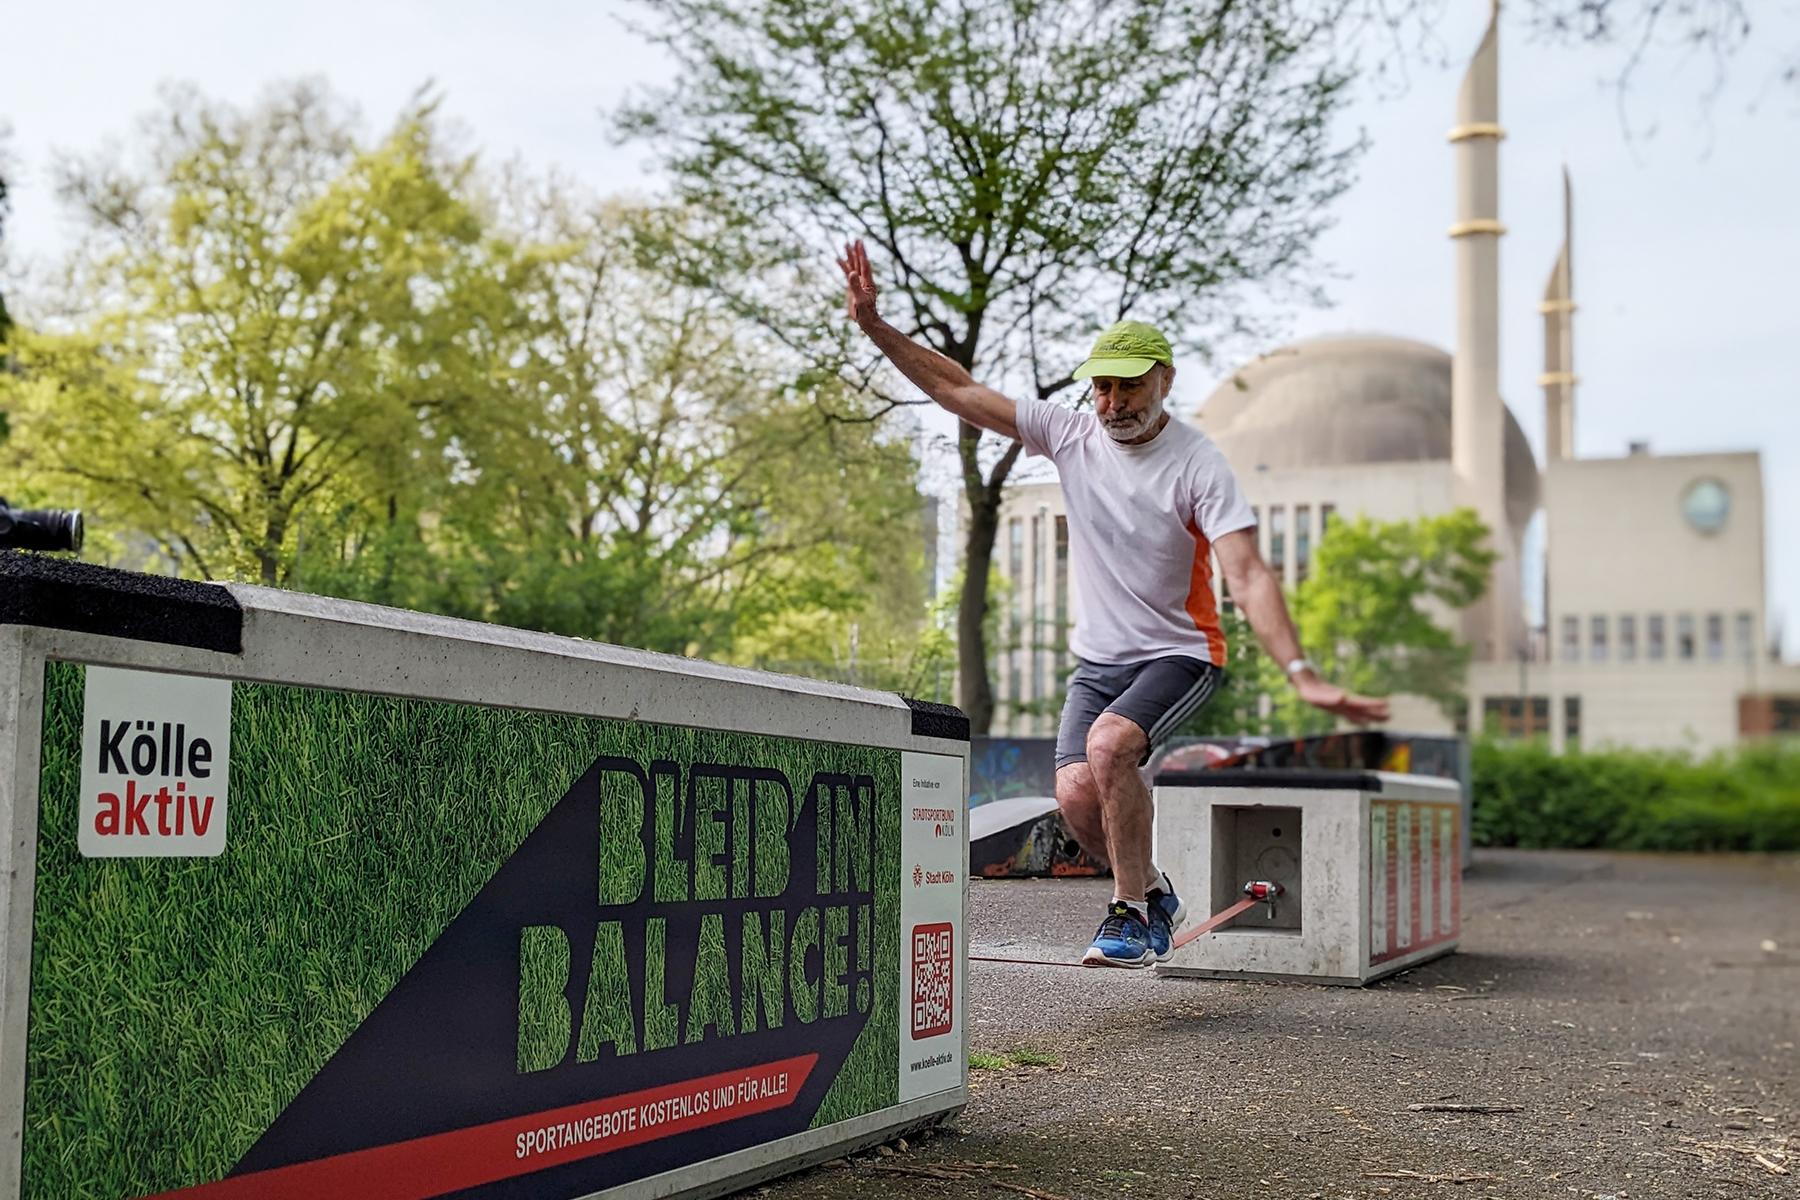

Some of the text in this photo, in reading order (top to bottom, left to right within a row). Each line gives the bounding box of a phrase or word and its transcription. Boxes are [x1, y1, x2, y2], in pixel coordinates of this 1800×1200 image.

[98, 719, 213, 778] Kölle
[94, 780, 215, 837] aktiv
[599, 768, 872, 906] BLEIB IN
[912, 808, 955, 822] STADTSPORTBUND
[925, 870, 955, 884] Stadt Köln
[516, 904, 871, 1074] BALANCE!
[515, 1072, 788, 1159] SPORTANGEBOTE KOSTENLOS UND FÜR ALLE!
